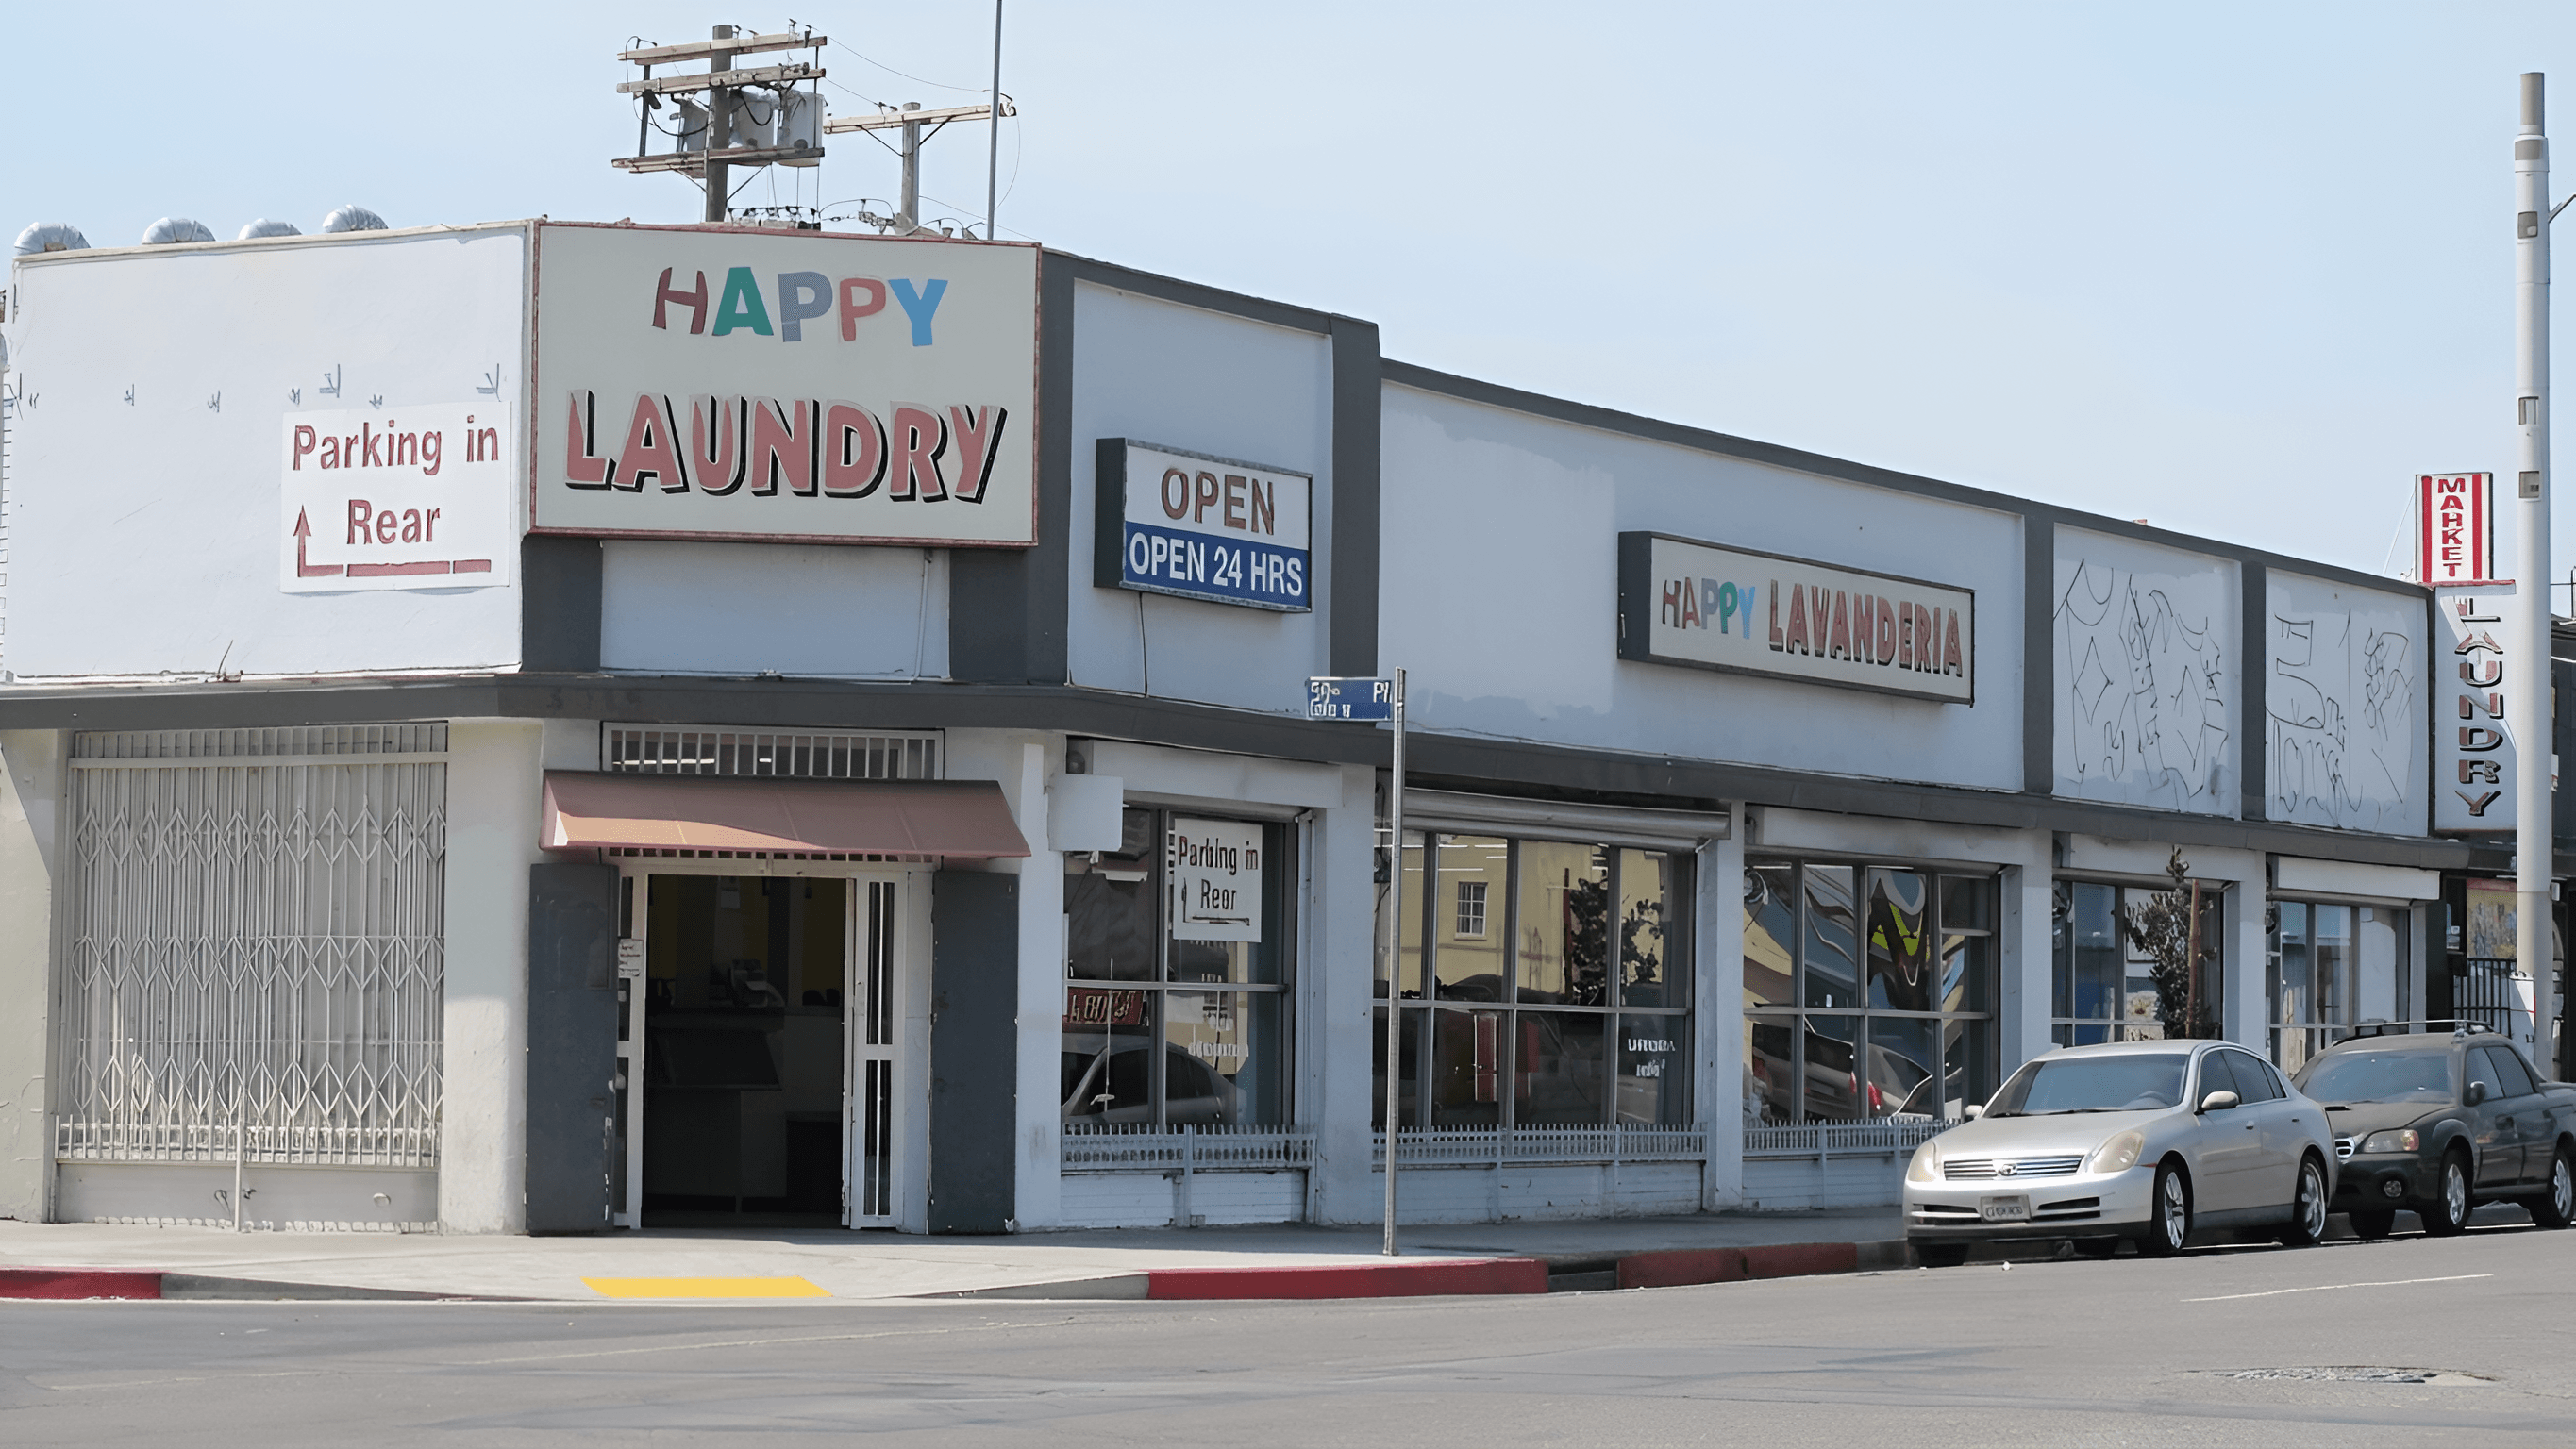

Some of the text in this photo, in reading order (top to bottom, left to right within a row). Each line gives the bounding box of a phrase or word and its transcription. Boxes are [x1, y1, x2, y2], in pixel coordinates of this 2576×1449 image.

[651, 266, 949, 347] HAPPY
[293, 415, 499, 475] Parking in
[564, 389, 1008, 505] LAUNDRY
[346, 499, 441, 544] Rear
[1161, 467, 1275, 535] OPEN
[2437, 477, 2466, 577] MARKET
[1129, 532, 1302, 596] OPEN 24 HRS
[1662, 576, 1964, 678] HAPPY LAVANDERIA
[2453, 596, 2505, 817] LAUNDRY
[1179, 836, 1259, 875] Parking in
[1200, 879, 1237, 910] Rear
